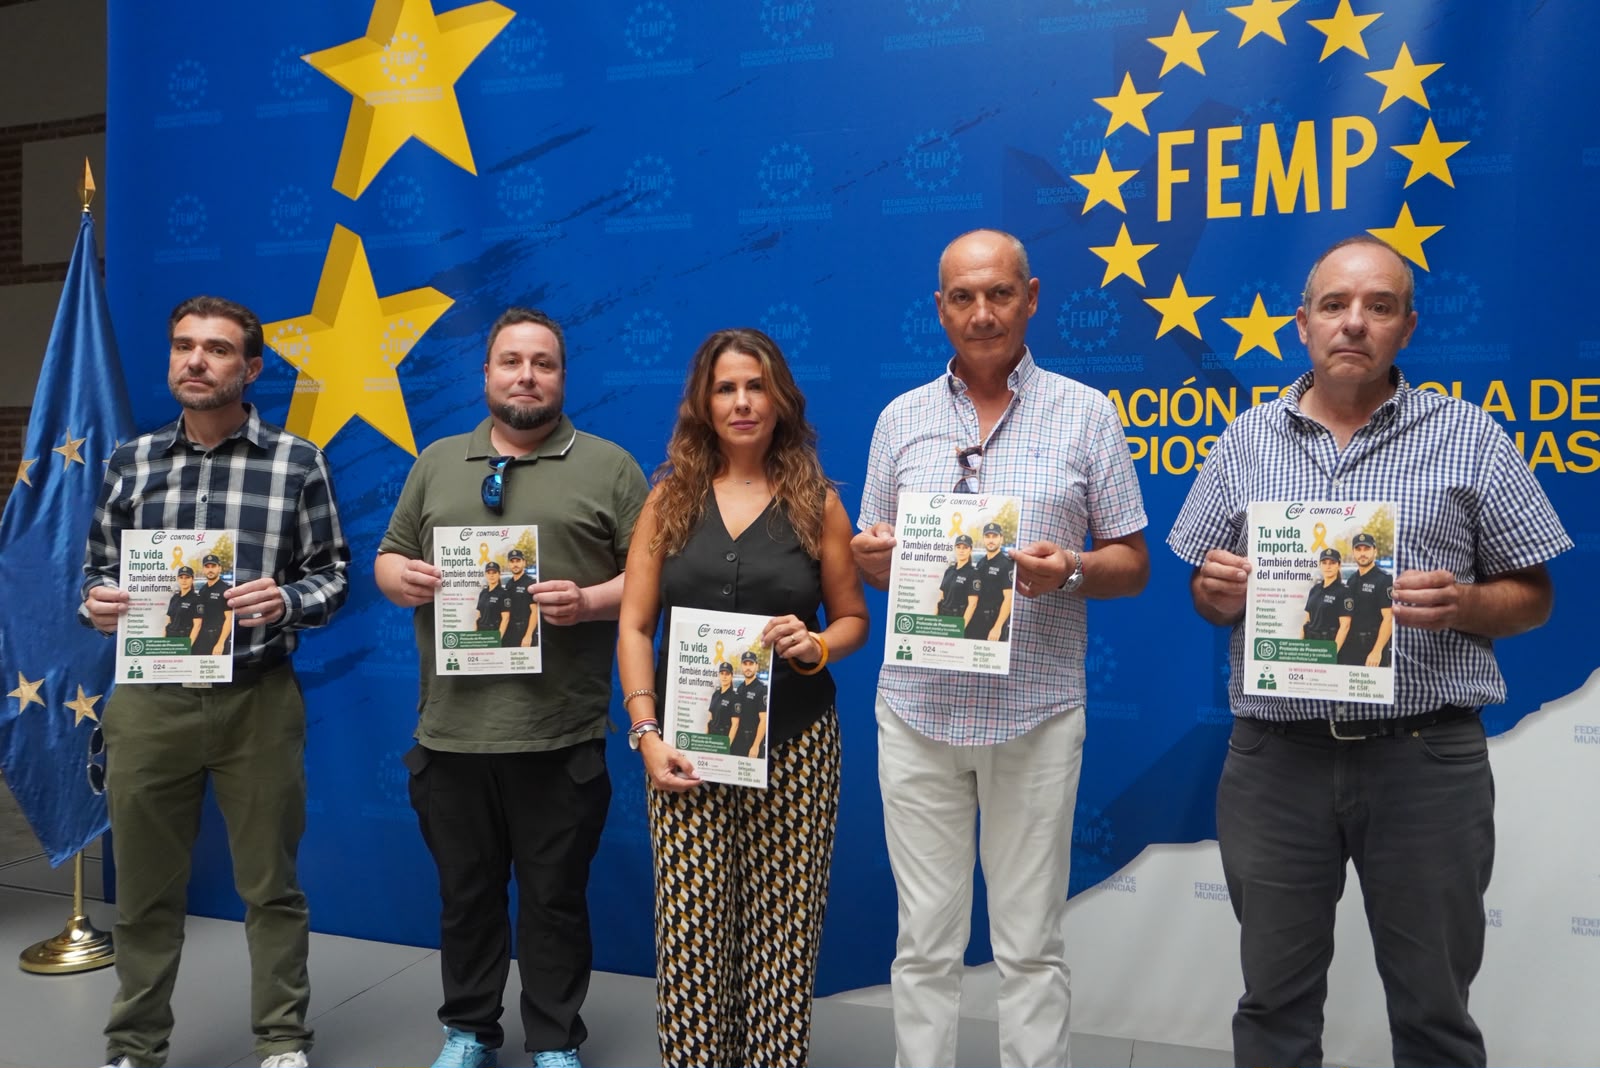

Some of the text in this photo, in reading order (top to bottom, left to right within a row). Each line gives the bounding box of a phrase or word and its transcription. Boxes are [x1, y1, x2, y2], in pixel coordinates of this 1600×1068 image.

[771, 4, 804, 23] FEMP
[635, 20, 667, 39] FEMP
[916, 150, 951, 168] FEMP
[769, 162, 802, 180] FEMP
[1157, 115, 1378, 222] FEMP
[1071, 311, 1109, 328] FEMP
[914, 317, 945, 335] FEM
[1530, 378, 1600, 421] DE
[906, 514, 941, 525] Tu vida
[903, 526, 945, 539] importa.
[1258, 527, 1300, 538] Tu vida
[441, 546, 470, 555] Tu vida
[902, 541, 953, 551] También detrás
[1258, 541, 1307, 555] importa.
[130, 550, 163, 559] Tu vida
[901, 552, 912, 560] del
[129, 562, 168, 571] importa.
[441, 557, 476, 568] importa.
[1258, 557, 1318, 568] También detrás
[1257, 570, 1270, 580] del
[128, 584, 138, 592] del
[680, 641, 707, 653] Tu vida
[680, 653, 711, 666] importa.
[679, 666, 701, 674] También
[679, 677, 687, 685] del
